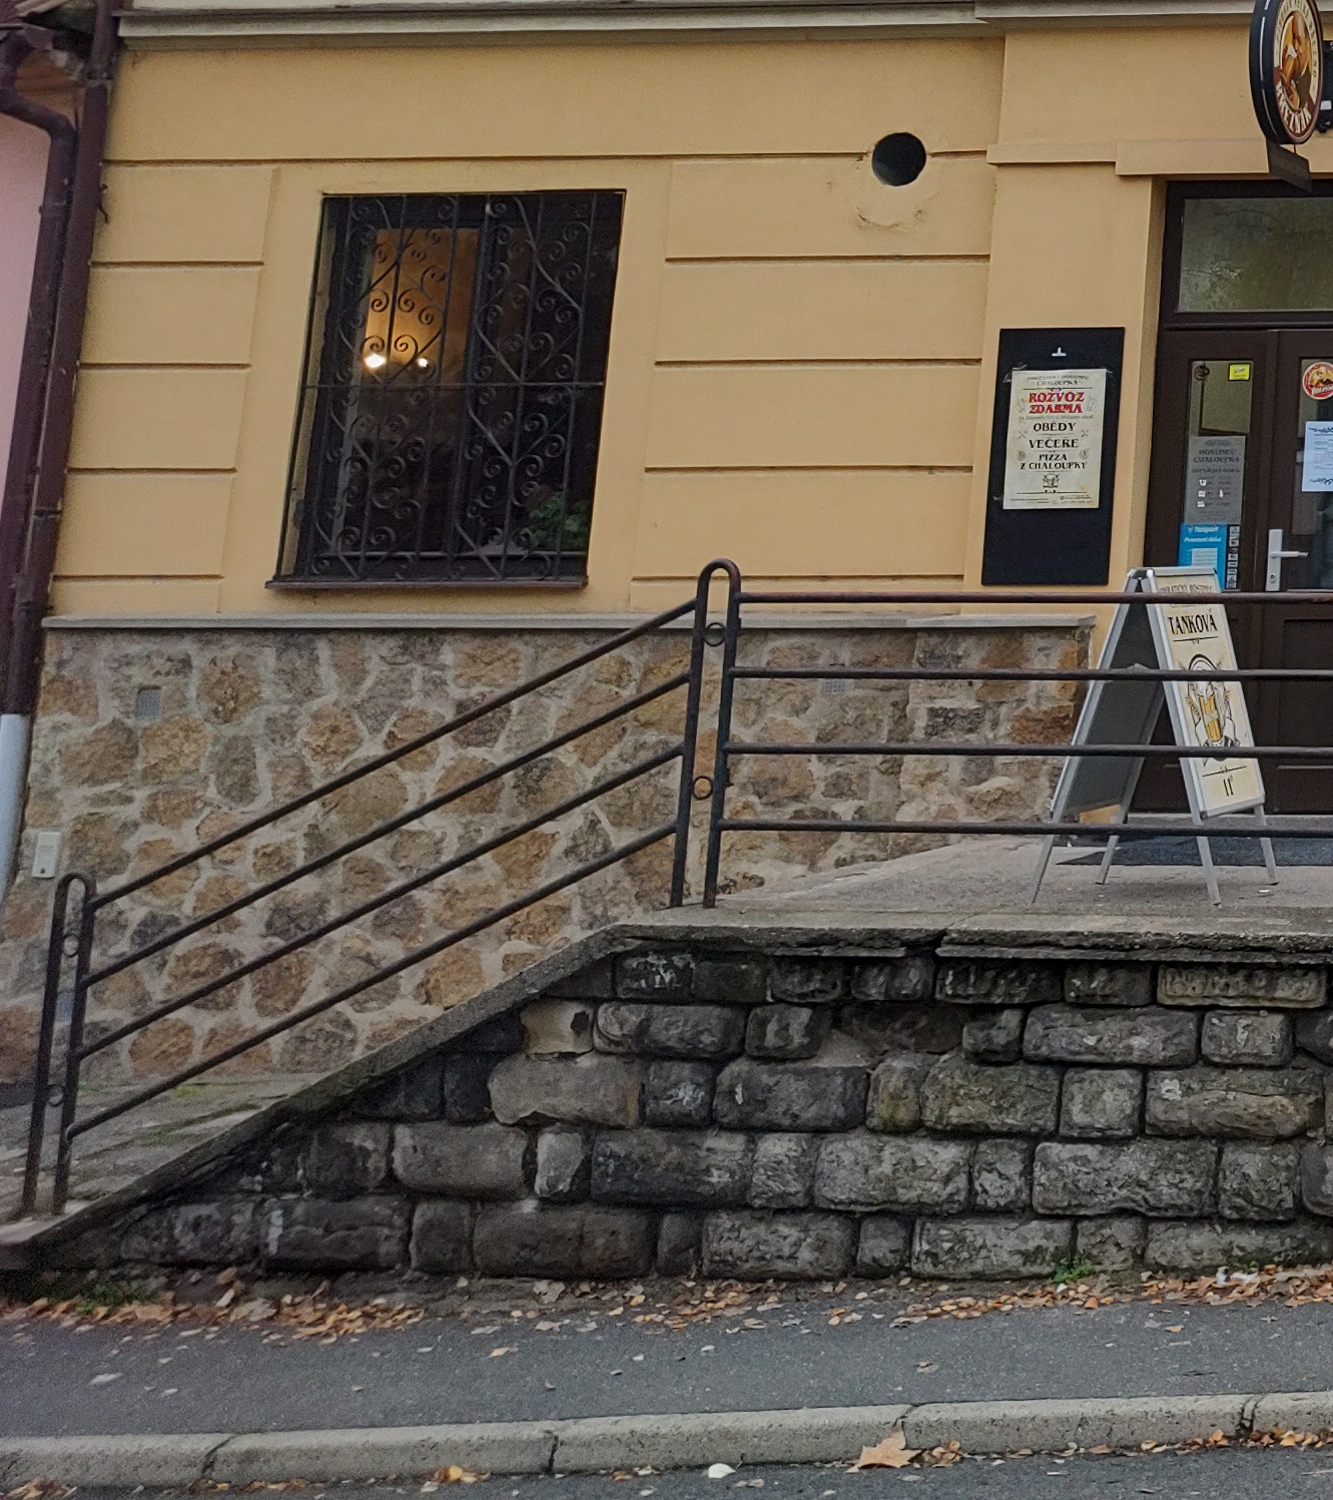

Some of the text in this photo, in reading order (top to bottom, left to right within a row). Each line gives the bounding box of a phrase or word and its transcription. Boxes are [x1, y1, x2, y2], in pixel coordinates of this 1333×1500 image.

[1028, 391, 1086, 403] ROZVOZ
[1028, 403, 1084, 415] ZDARMA
[1033, 421, 1077, 432] OBĚDY
[1029, 436, 1080, 449] VEČEŘE
[1038, 453, 1068, 462] PIZZA
[1168, 607, 1218, 635] TANKOVÁ
